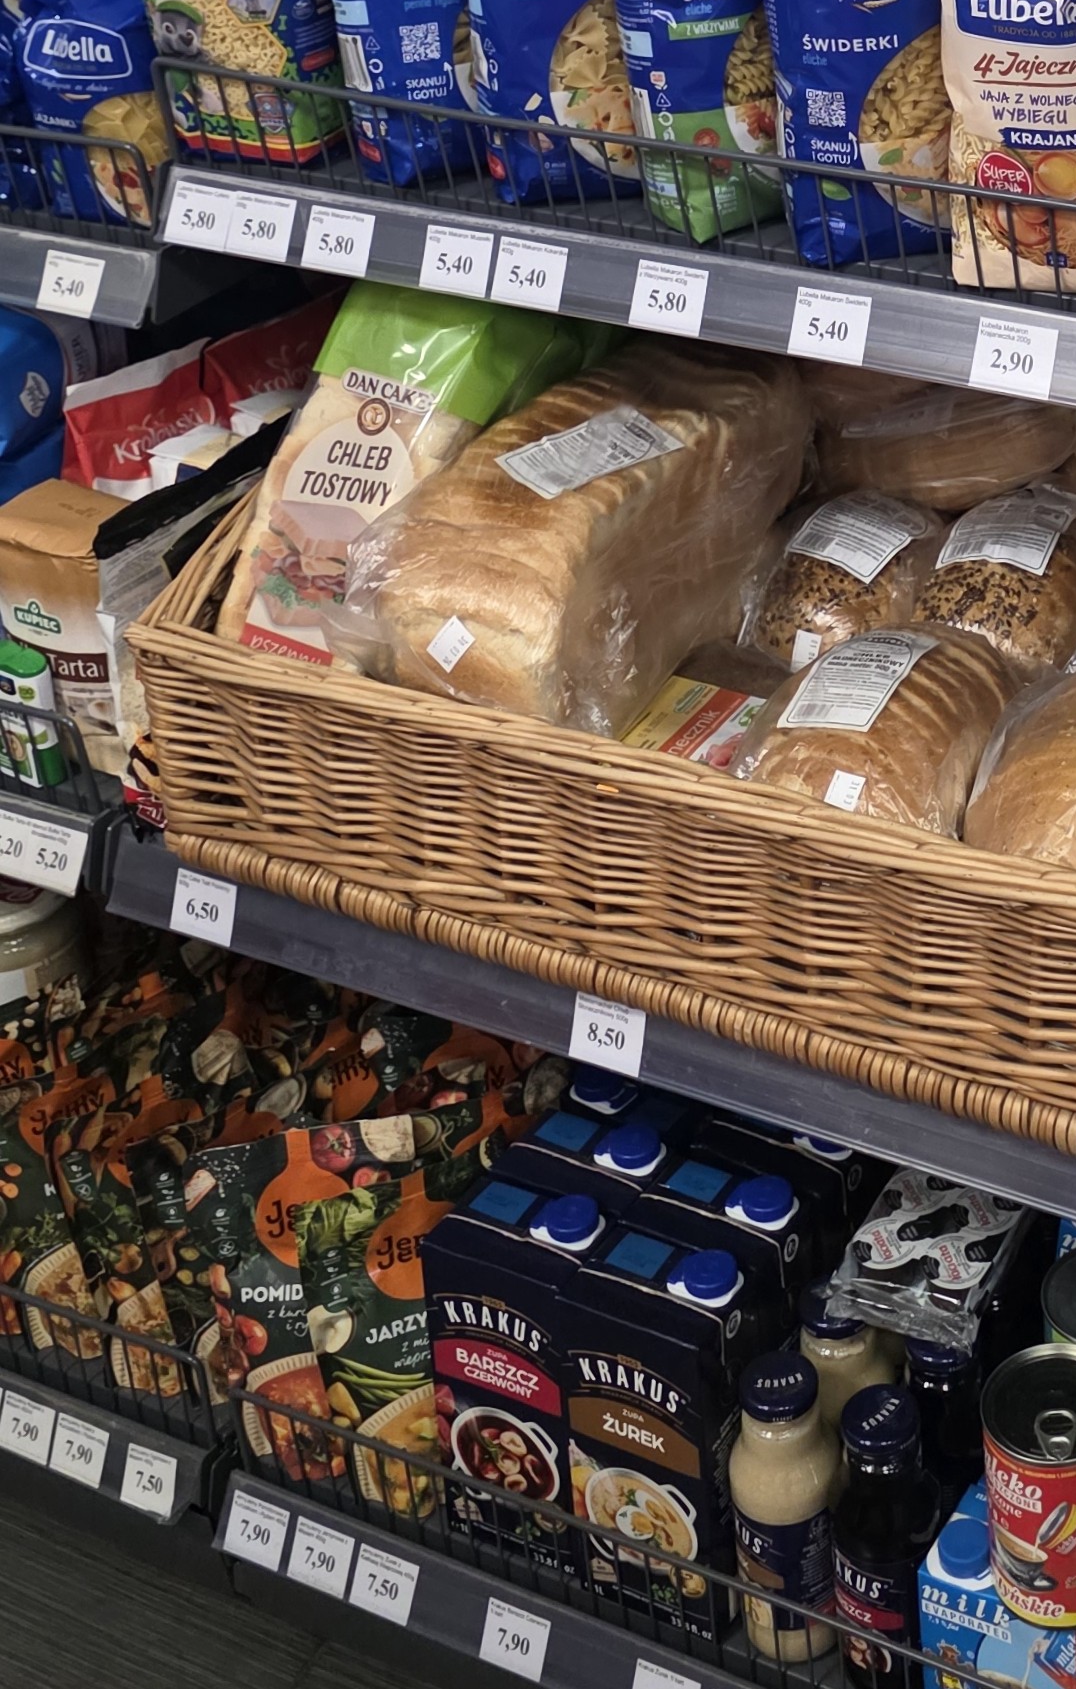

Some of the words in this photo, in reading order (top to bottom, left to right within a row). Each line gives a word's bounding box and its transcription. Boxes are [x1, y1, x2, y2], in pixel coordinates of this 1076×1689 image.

[802, 33, 899, 53] ŚWIDERKI
[405, 78, 446, 90] SKANUJ
[979, 90, 1011, 105] JAJA
[991, 106, 1068, 125] WYBIEGU
[983, 163, 1026, 183] SUPER
[181, 208, 216, 231] 5,80
[241, 217, 277, 241] 5,80
[318, 234, 354, 256] 5,80
[436, 252, 473, 276] 5,40
[52, 274, 85, 298] 5,40
[508, 265, 547, 289] 5,40
[807, 316, 849, 343] 5,40
[989, 348, 1034, 375] 2,90
[347, 372, 379, 395] DAN
[327, 440, 393, 471] CHLEB
[300, 471, 393, 507] TOSTOWY
[16, 610, 59, 632] KUPIEC
[35, 842, 69, 873] 5,20
[185, 900, 220, 923] 6,50
[587, 1022, 626, 1050] 8,50
[443, 1300, 542, 1353] KRAKUS
[455, 1347, 540, 1392] BARSZCZ
[464, 1364, 534, 1400] CZERWONY
[578, 1356, 680, 1414] KRAKUS
[10, 1418, 40, 1442] 7,90
[602, 1412, 666, 1454] ŻUREK
[64, 1439, 94, 1464] 7,90
[134, 1471, 164, 1496] 7,50
[239, 1519, 271, 1545] 7,90
[304, 1547, 336, 1572] 7,90
[367, 1573, 400, 1600] 7,50
[923, 1602, 1011, 1644] EVAPORATED
[497, 1628, 531, 1655] 7,90
